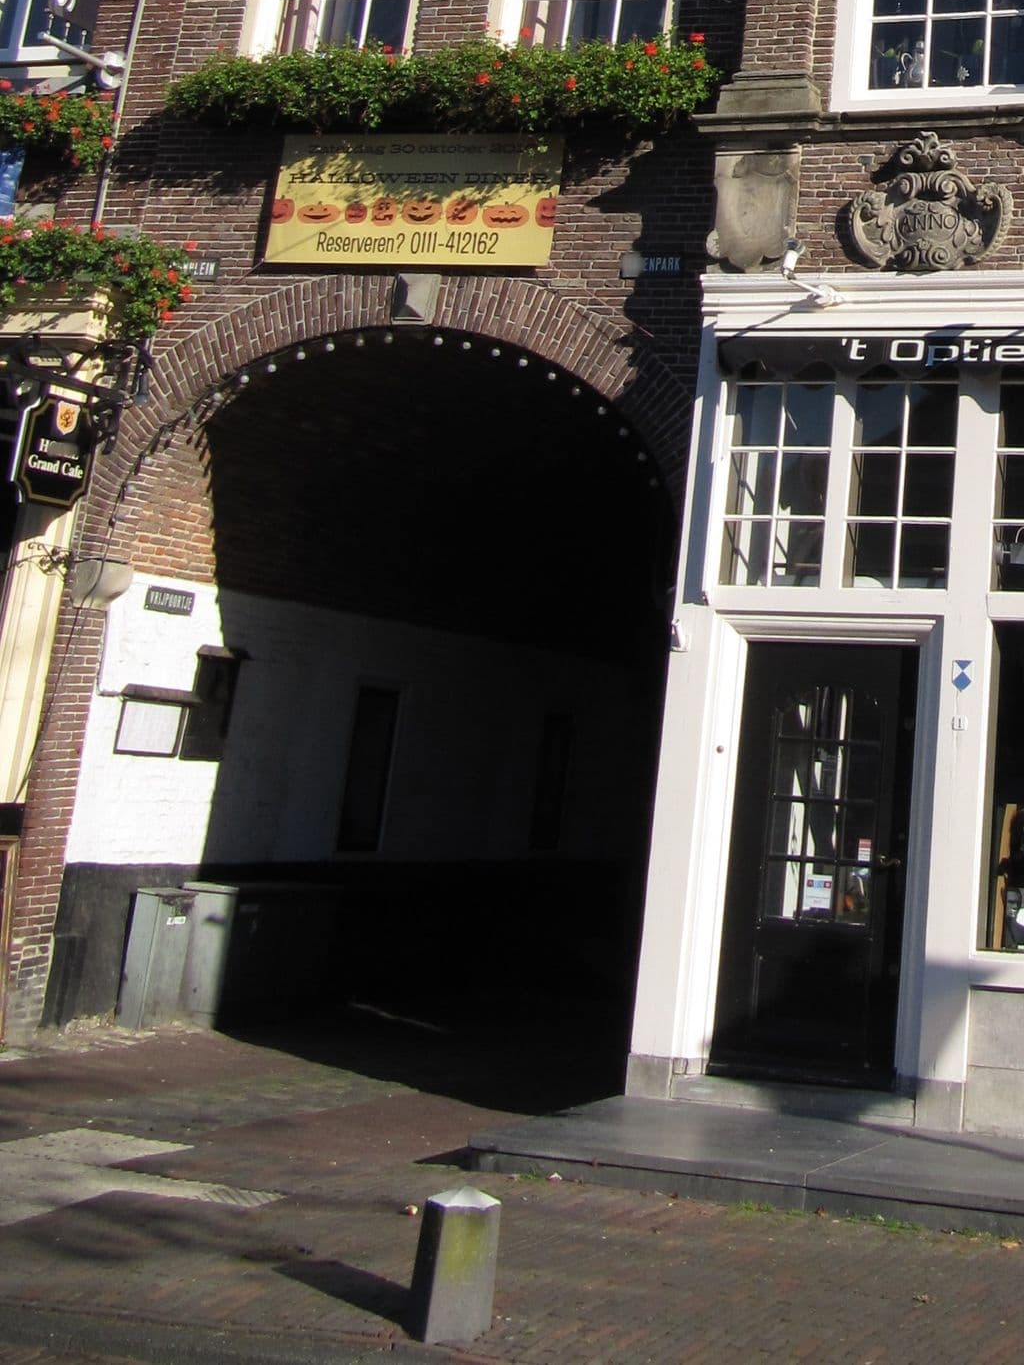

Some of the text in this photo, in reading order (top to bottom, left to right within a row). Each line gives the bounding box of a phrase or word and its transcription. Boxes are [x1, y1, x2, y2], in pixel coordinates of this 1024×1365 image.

[390, 143, 417, 155] 30
[418, 143, 485, 155] oktober
[288, 172, 551, 185] HALLOWEEN DINER
[901, 214, 957, 233] ANNO
[316, 230, 500, 255] Reserveren? 0111-412162
[624, 256, 681, 272] ENPARK
[841, 337, 868, 362] 't
[28, 453, 84, 479] Grand Cafe
